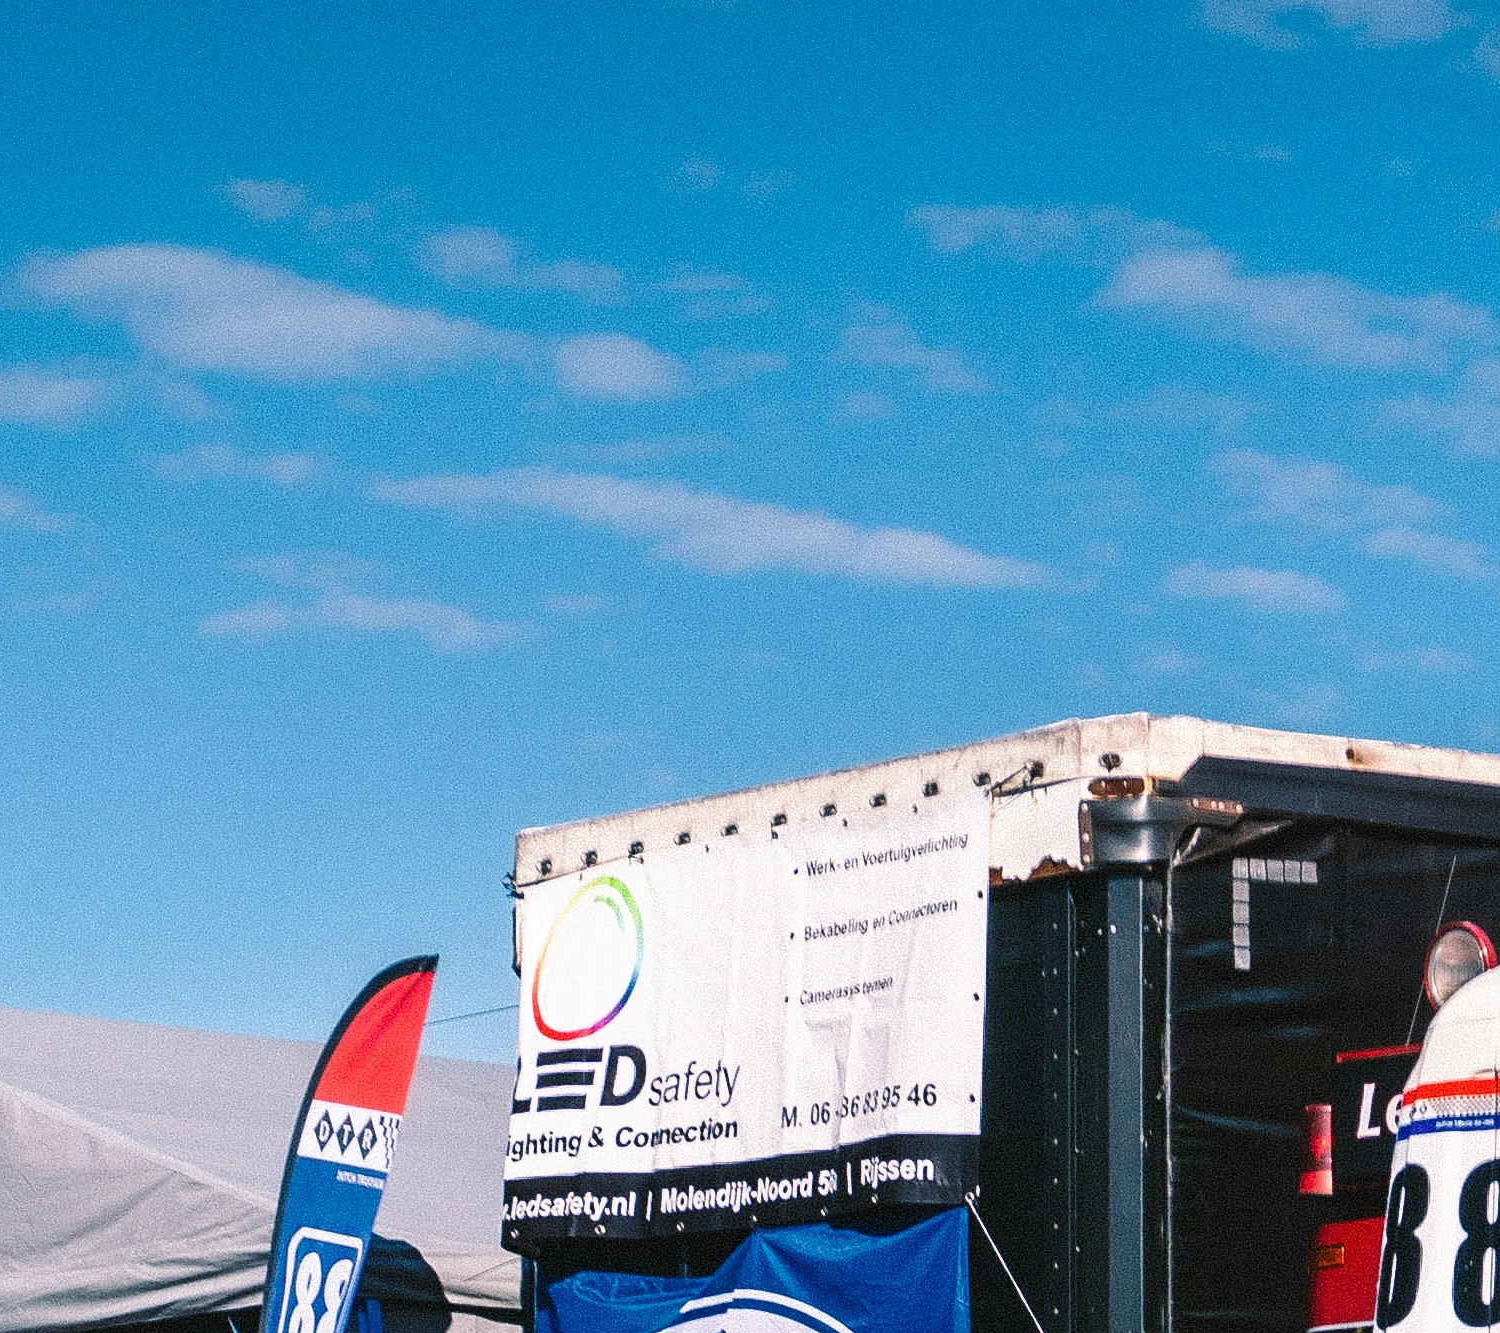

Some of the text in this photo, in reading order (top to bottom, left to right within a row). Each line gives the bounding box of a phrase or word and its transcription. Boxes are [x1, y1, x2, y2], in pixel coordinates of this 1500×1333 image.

[843, 855, 859, 871] en
[861, 832, 969, 867] Voertuigverlichting
[803, 899, 958, 942] Bekabeling en Connectoren
[809, 1097, 831, 1126] 06
[880, 1085, 901, 1111] 95
[906, 1083, 938, 1108] 46
[505, 1117, 740, 1162] ighting & Connection
[859, 1154, 935, 1189] Rijssen
